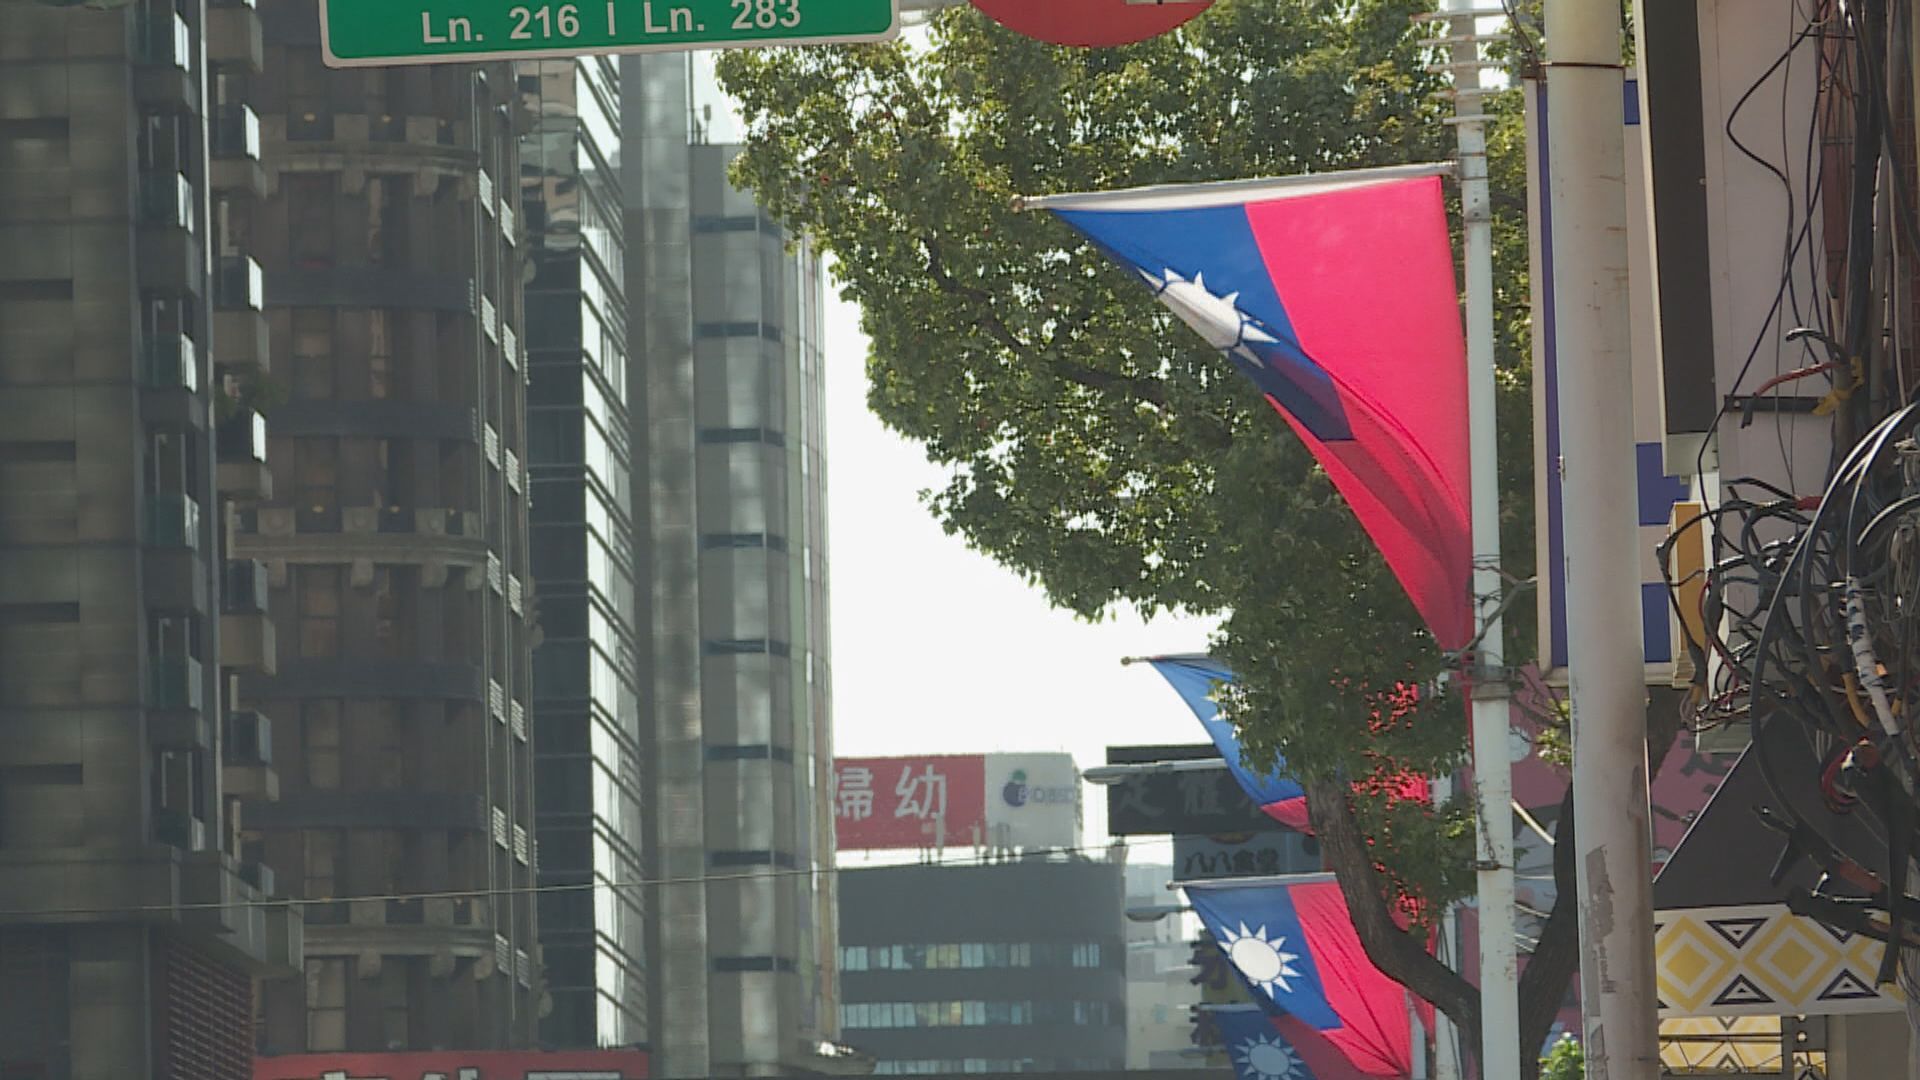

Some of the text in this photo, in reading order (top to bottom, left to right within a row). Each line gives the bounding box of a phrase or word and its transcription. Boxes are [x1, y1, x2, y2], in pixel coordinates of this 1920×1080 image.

[421, 12, 484, 44] Ln.
[509, 4, 581, 39] 216
[642, 1, 706, 34] Ln.
[731, 0, 801, 30] 283
[834, 764, 947, 821] 婦幼
